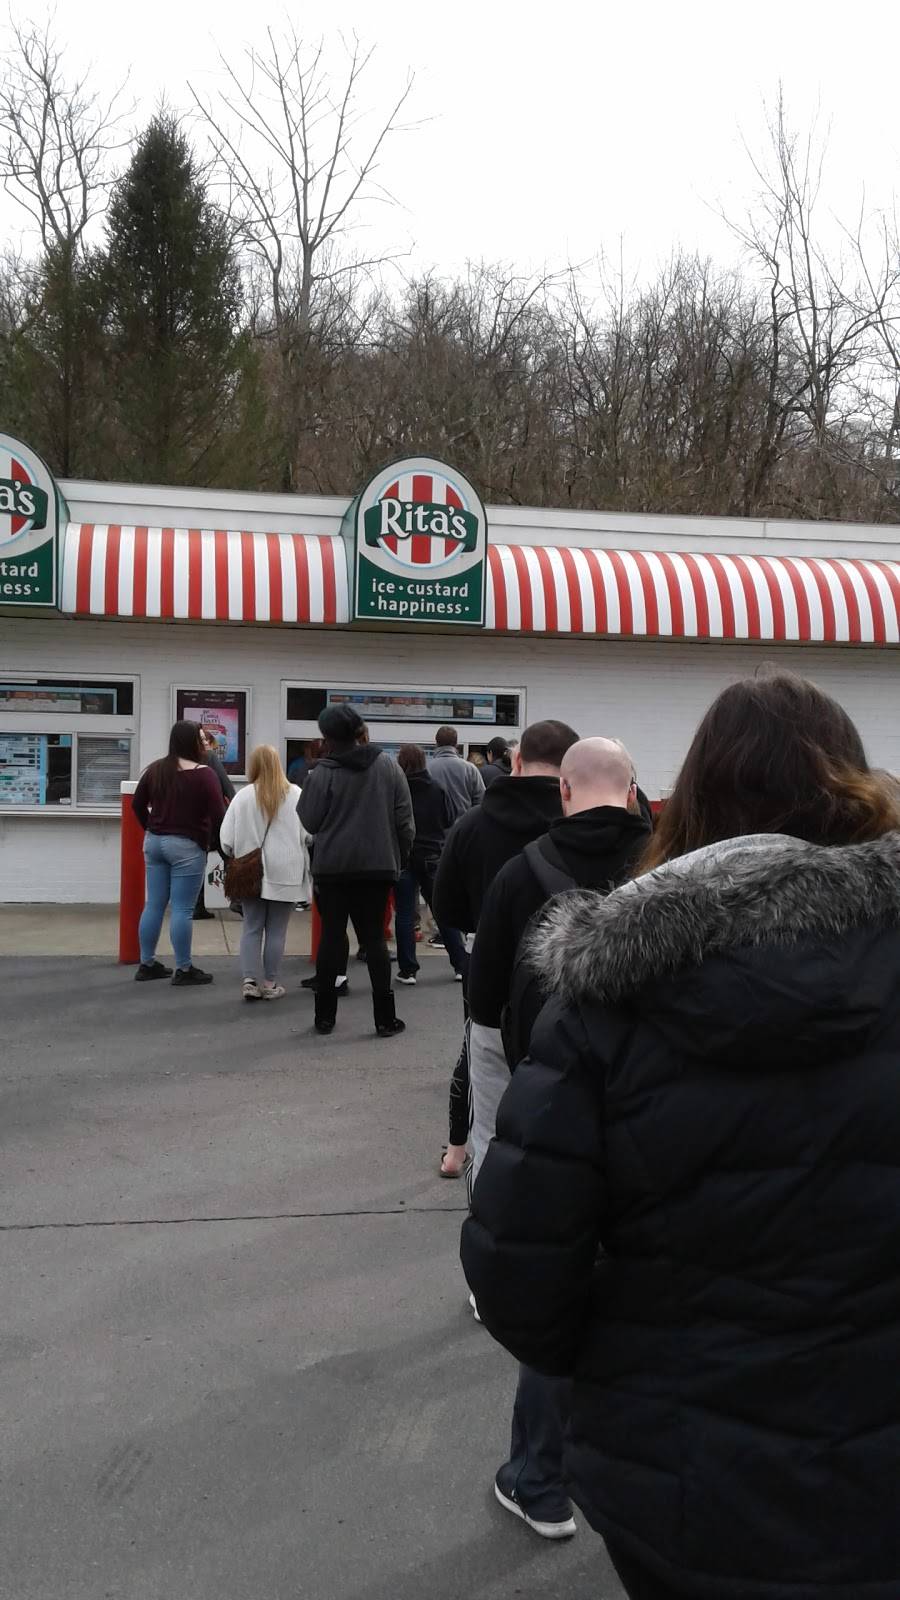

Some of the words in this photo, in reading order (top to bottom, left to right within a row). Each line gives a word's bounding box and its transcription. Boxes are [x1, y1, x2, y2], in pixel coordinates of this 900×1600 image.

[379, 498, 468, 539] Rita's
[372, 578, 396, 593] ice
[407, 582, 469, 597] custard
[378, 595, 462, 616] happiness
